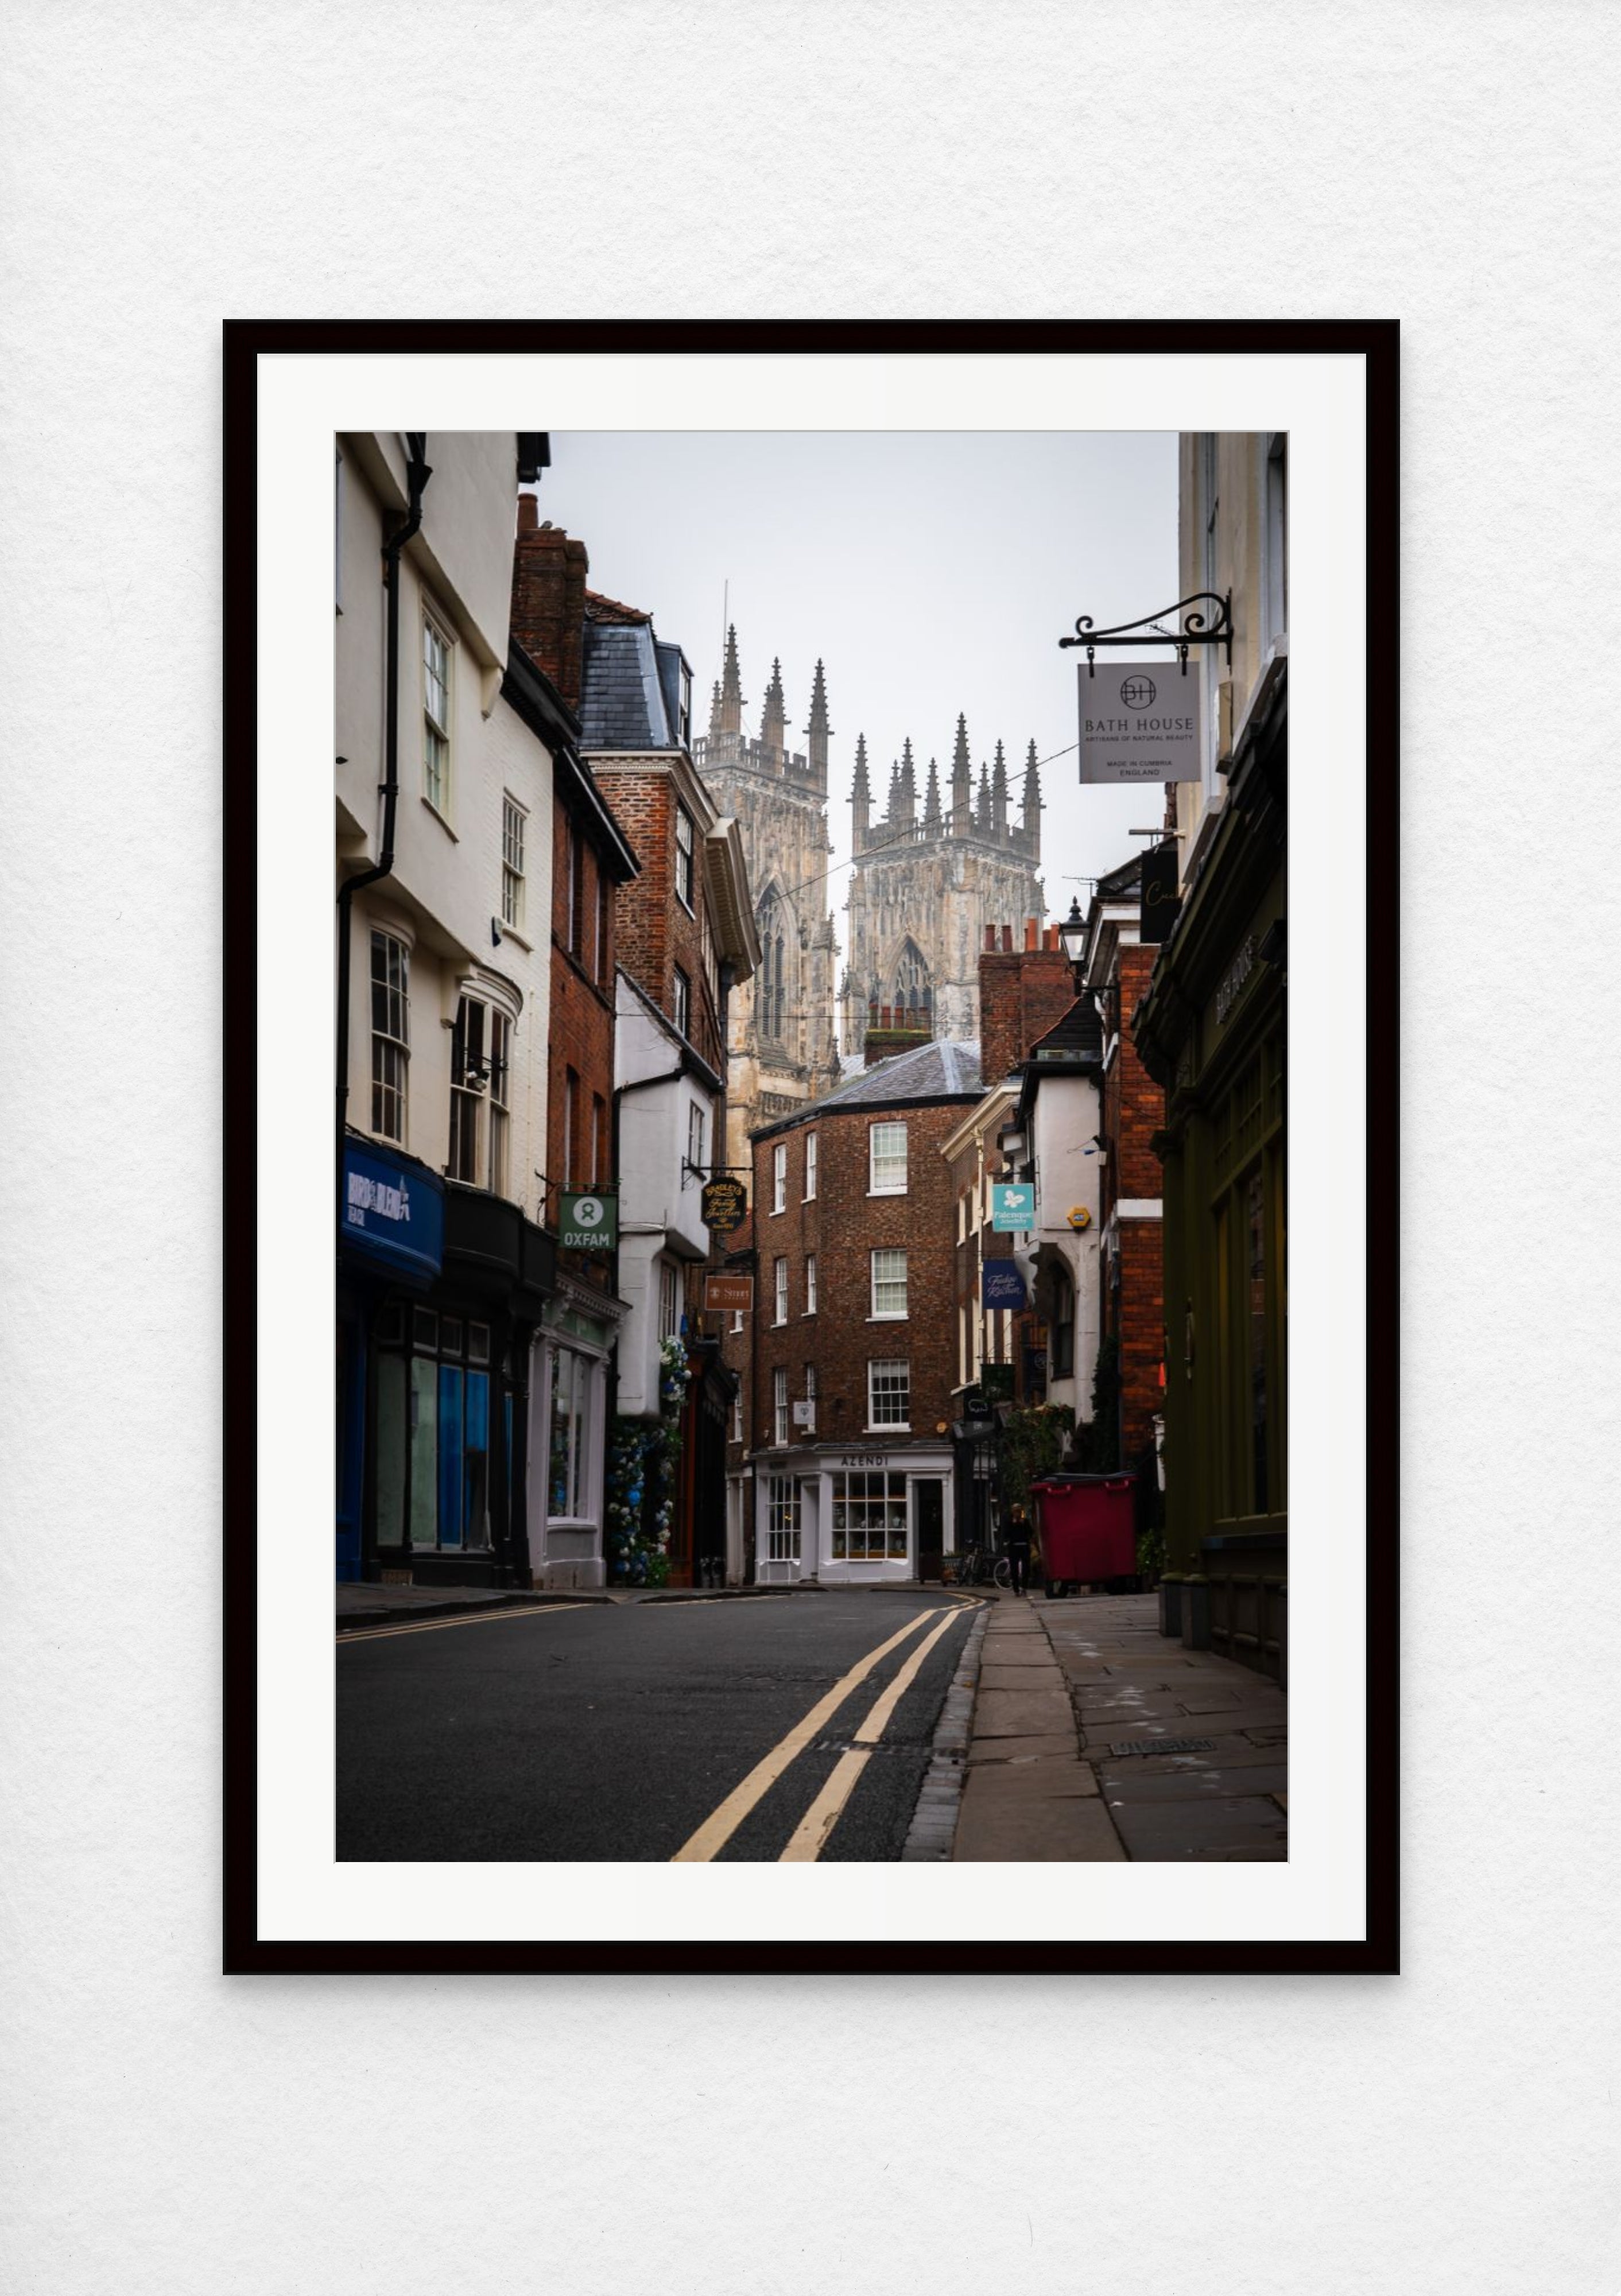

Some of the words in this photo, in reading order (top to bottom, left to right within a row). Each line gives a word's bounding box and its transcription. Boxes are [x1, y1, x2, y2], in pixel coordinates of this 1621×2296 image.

[1085, 719, 1129, 732] BATH
[1137, 718, 1193, 731] HOUSE
[564, 1233, 609, 1246] OXFAM
[841, 1456, 888, 1466] AZENDI
